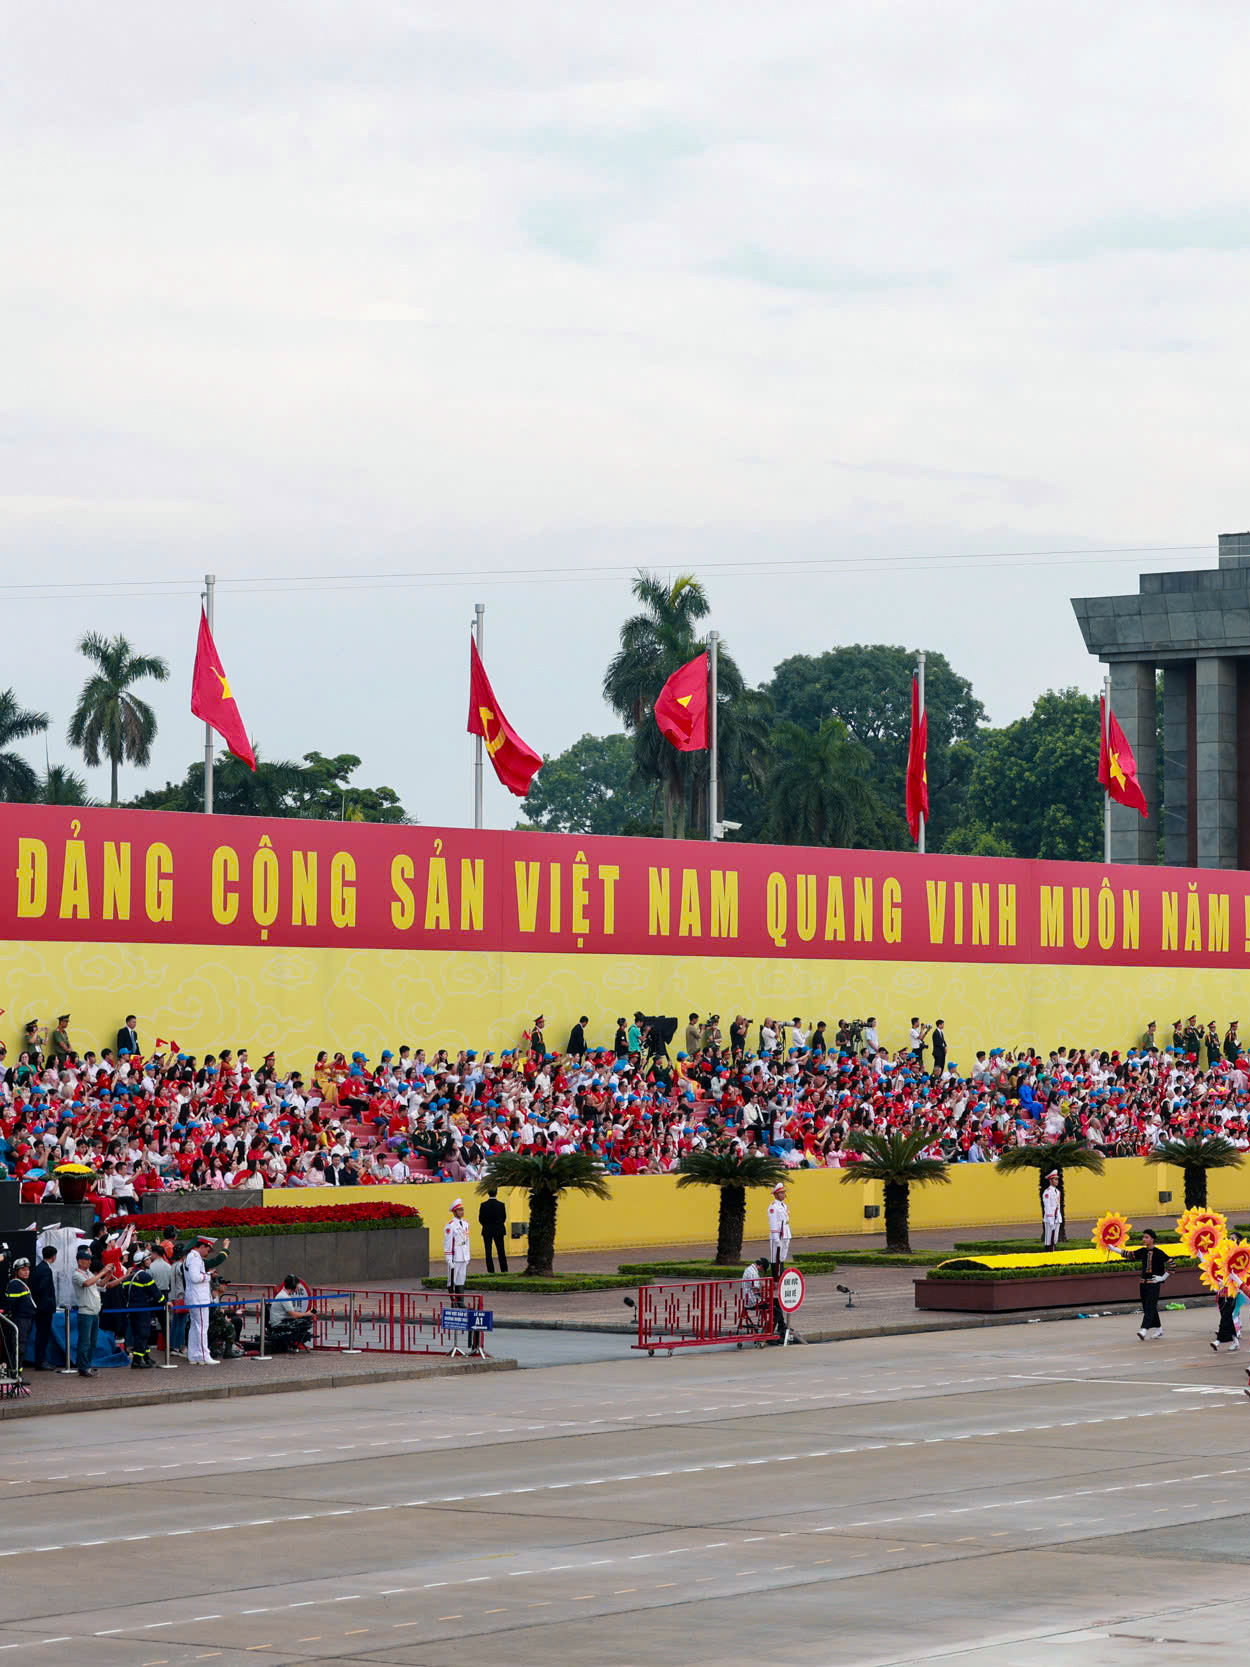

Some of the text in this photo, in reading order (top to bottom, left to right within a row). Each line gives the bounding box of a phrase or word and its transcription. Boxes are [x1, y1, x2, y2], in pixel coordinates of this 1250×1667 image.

[16, 820, 173, 922] ĐẢNG
[212, 835, 357, 940] CỘNG
[391, 839, 485, 930] SẢN
[515, 851, 620, 948] VIỆT
[649, 867, 739, 938] NAM
[767, 872, 902, 947] QUANG
[926, 880, 1016, 945] VINH
[1040, 878, 1140, 950] MUÔN
[475, 1317, 483, 1326] A1
